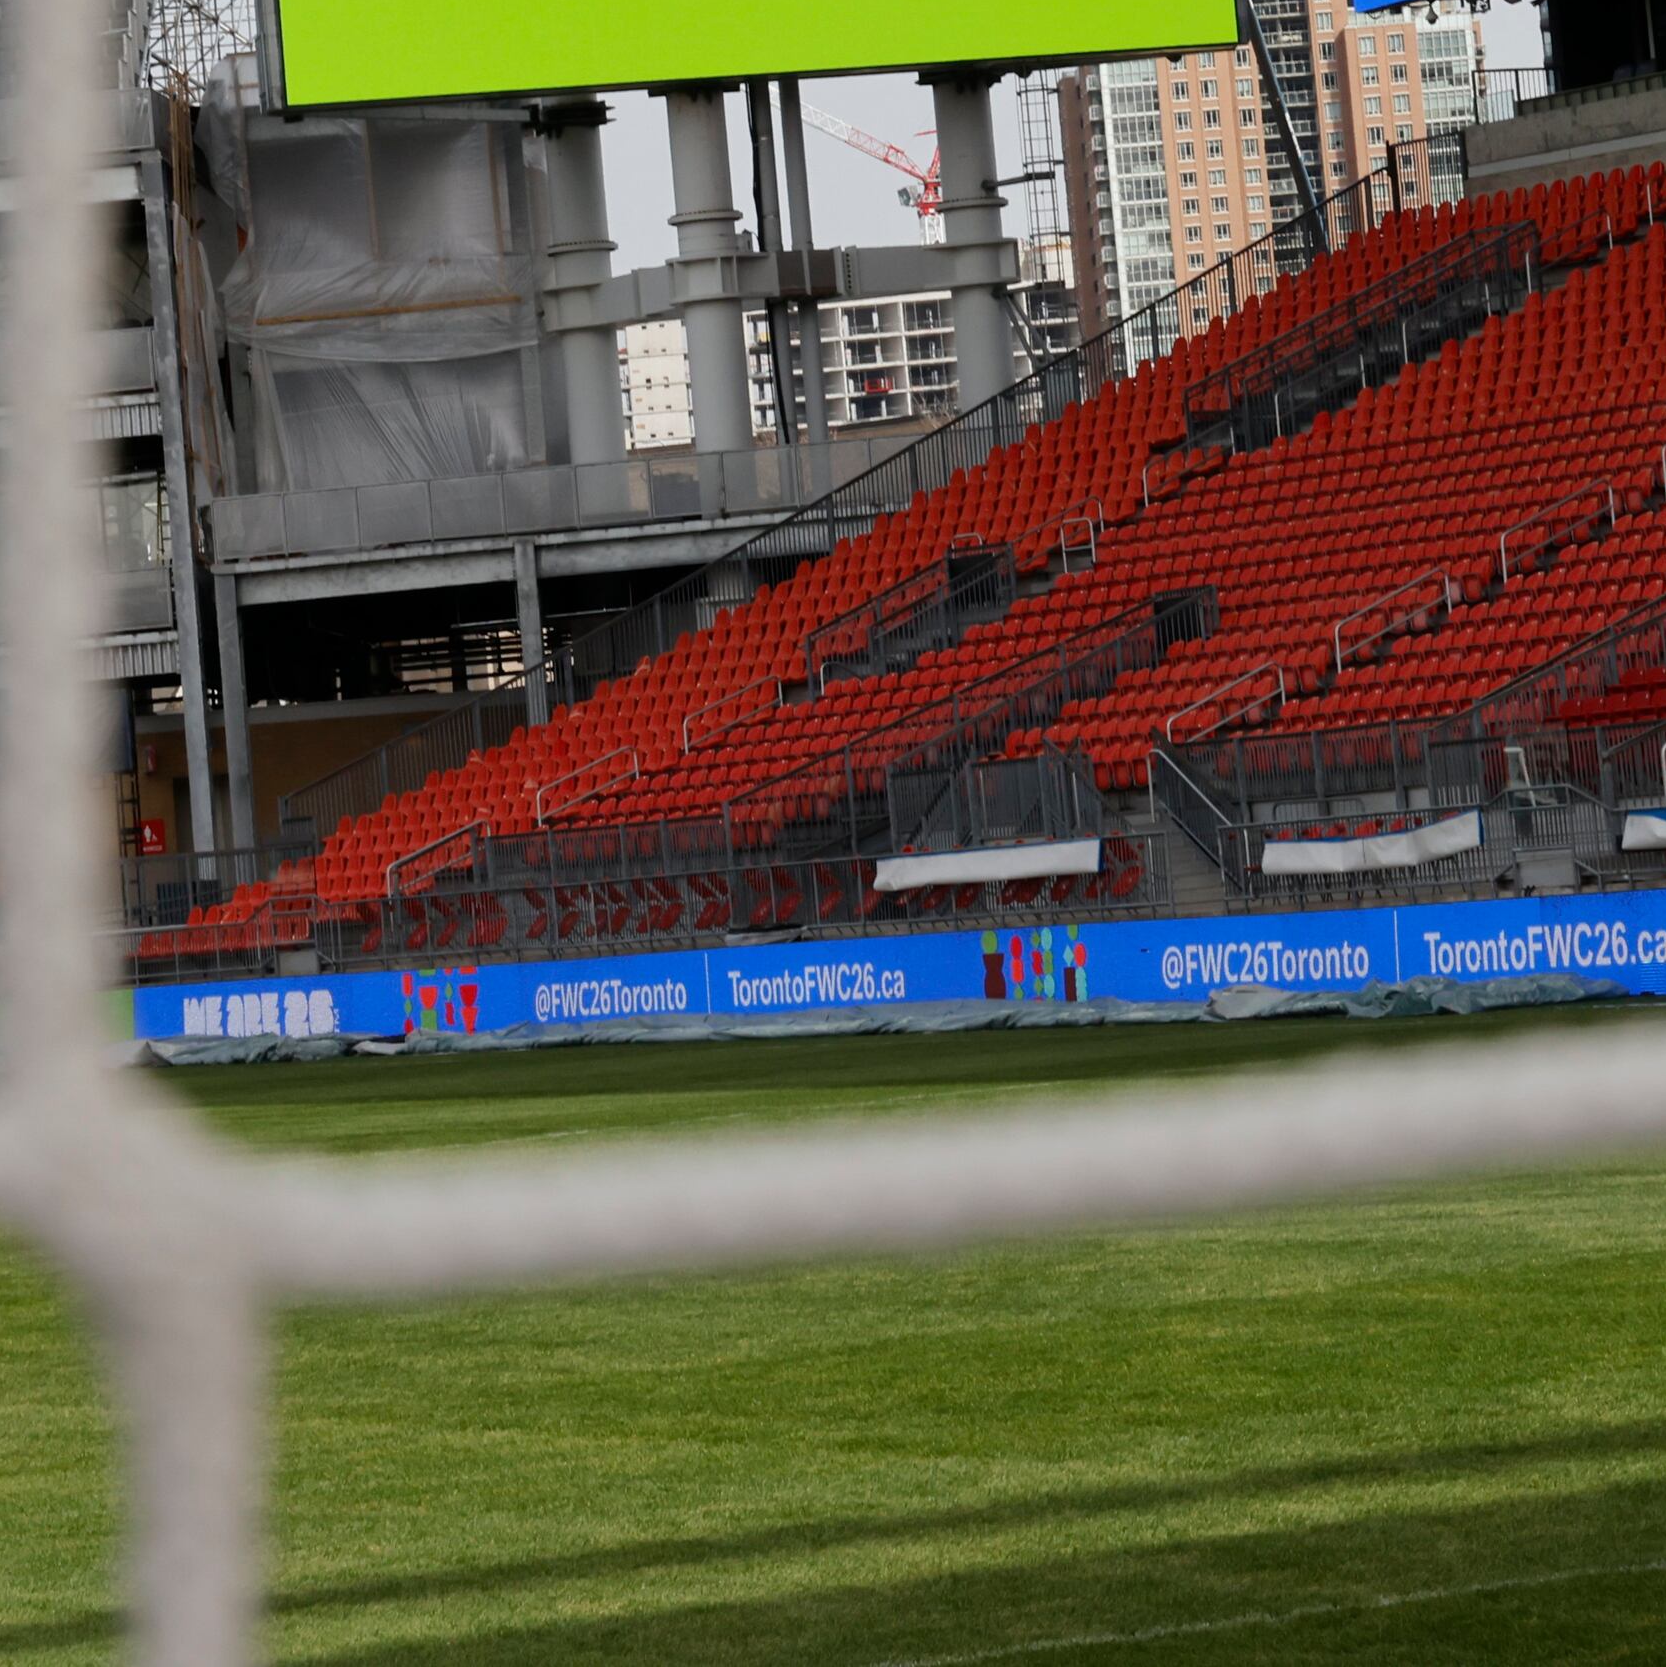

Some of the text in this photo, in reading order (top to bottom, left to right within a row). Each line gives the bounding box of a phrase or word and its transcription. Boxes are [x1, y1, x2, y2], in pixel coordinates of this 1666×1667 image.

[728, 962, 907, 1007] TorontoFWC26.ca
[1162, 939, 1370, 991] @FWC26Toronto
[184, 996, 223, 1035] WE
[226, 993, 281, 1037] ARE
[284, 989, 334, 1038] 26
[535, 977, 687, 1021] @FWC26Toronto
